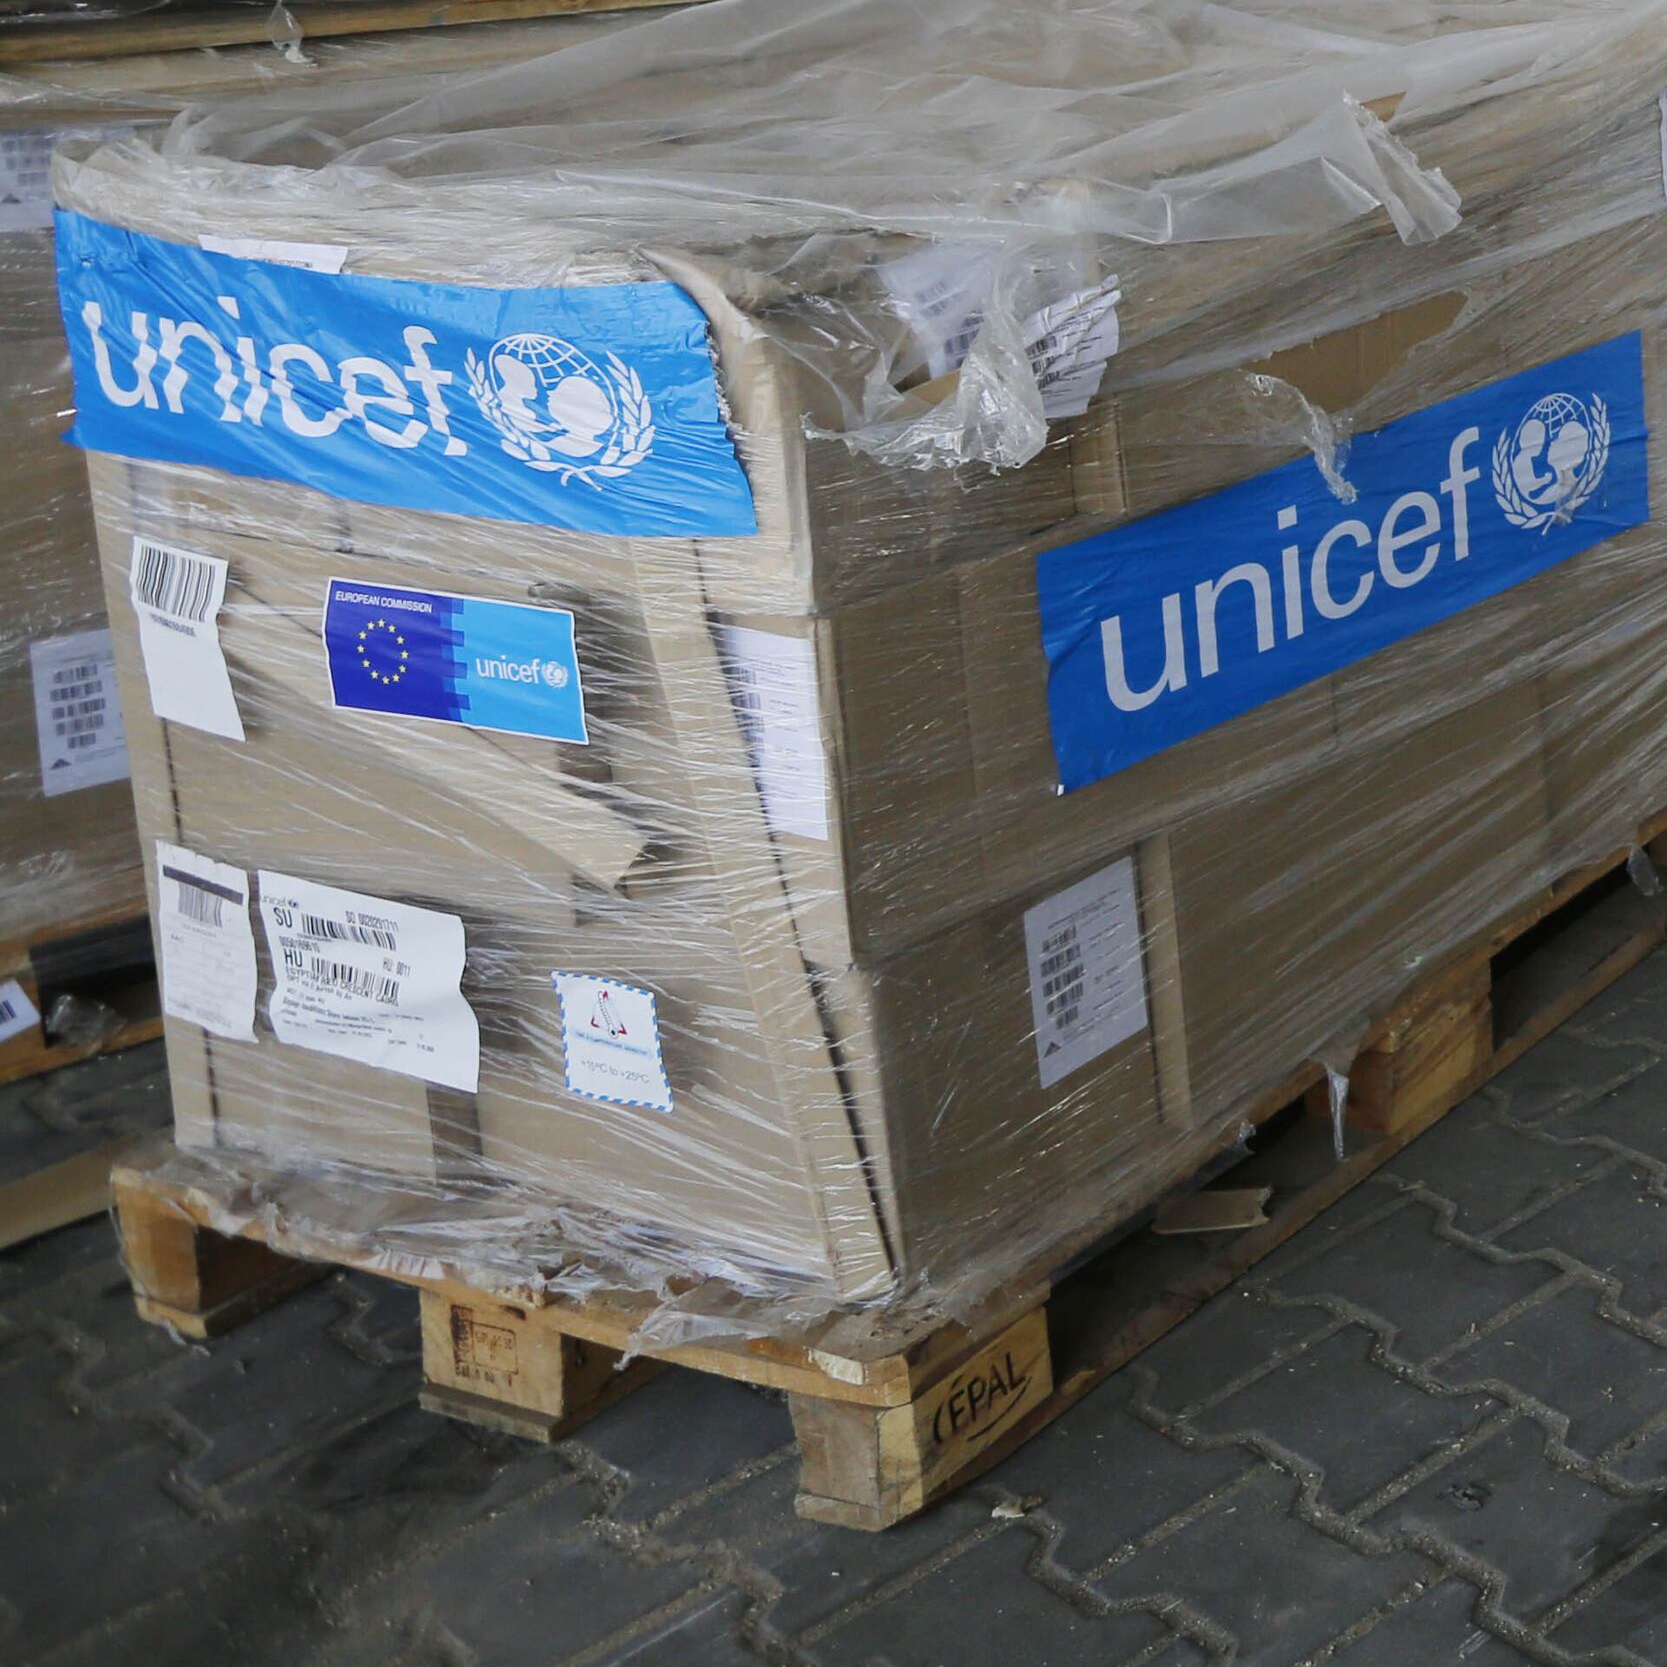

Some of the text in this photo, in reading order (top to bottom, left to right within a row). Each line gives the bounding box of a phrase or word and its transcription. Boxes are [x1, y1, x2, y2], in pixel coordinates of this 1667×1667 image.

[82, 296, 468, 456] unicef
[1102, 428, 1480, 711] unicef
[336, 590, 432, 613] EUROPEAN COMMISSION
[476, 655, 540, 684] unicef
[273, 907, 292, 928] SU
[284, 948, 303, 967] HU
